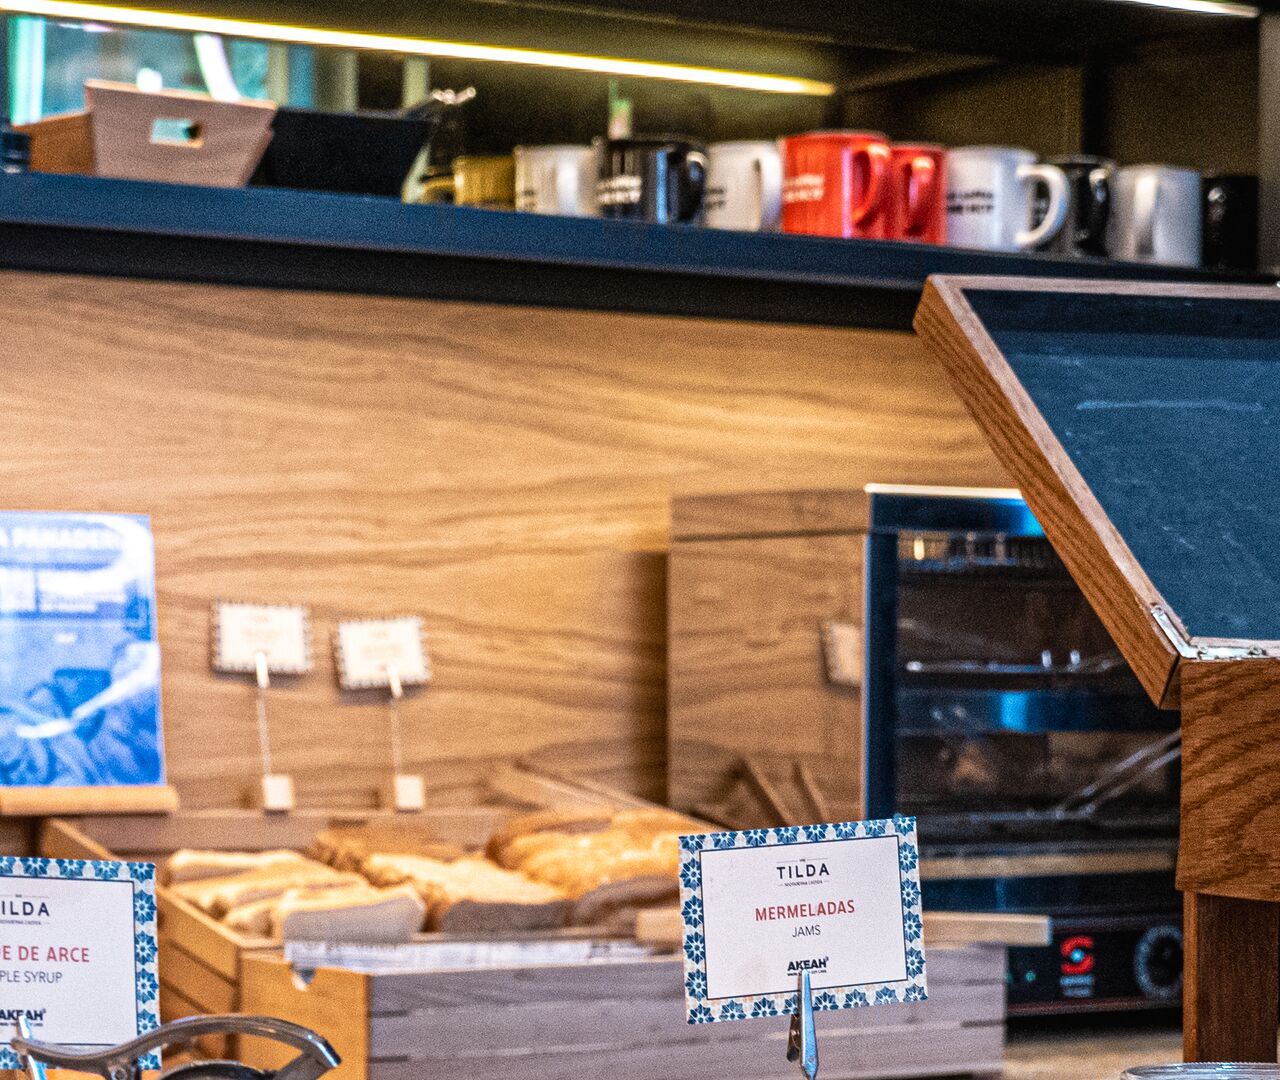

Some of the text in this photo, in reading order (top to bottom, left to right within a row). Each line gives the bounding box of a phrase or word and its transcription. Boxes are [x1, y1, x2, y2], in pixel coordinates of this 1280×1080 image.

[776, 863, 830, 880] TILDA
[755, 899, 855, 921] MERMELADAS
[792, 924, 822, 939] JAMS
[18, 945, 40, 962] DE
[46, 946, 90, 964] ARCE
[23, 970, 63, 985] SYRUP
